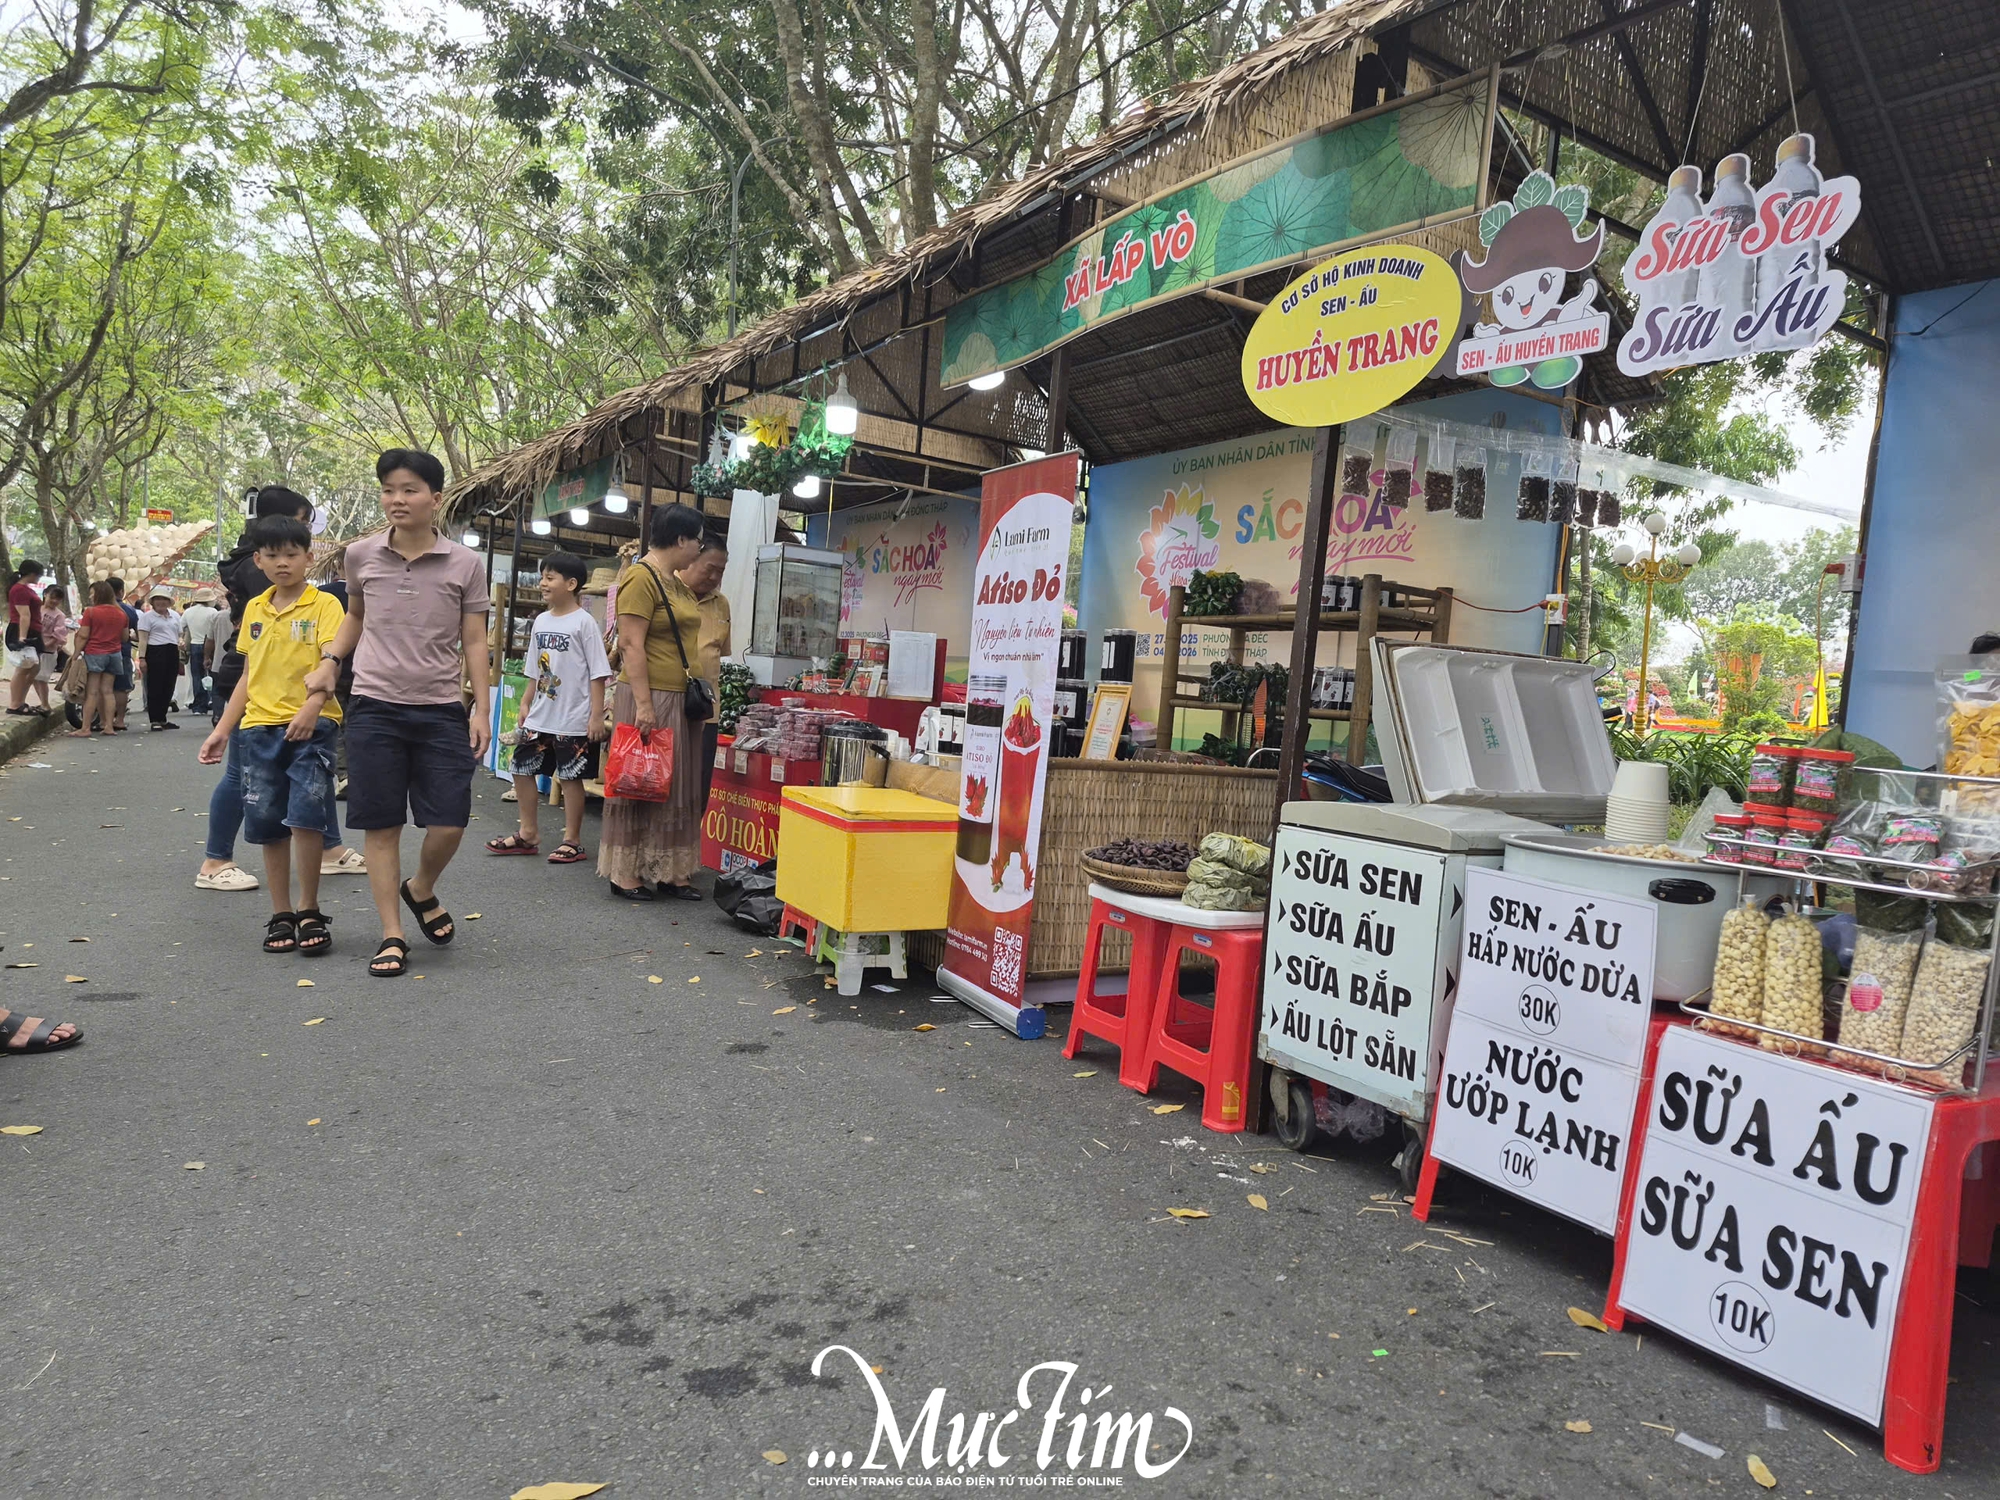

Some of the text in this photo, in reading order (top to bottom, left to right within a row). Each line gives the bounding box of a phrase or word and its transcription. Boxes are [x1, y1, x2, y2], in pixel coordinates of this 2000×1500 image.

[1062, 211, 1197, 312] XÃ LẤP VÒ
[1635, 191, 1844, 281] Sữa Sen
[1281, 257, 1425, 314] CƠ SỞ HỘ KINH DOANH
[1320, 296, 1347, 317] SEN
[1359, 284, 1377, 308] ẤU
[1628, 251, 1831, 363] Sữa Ấu
[1256, 318, 1439, 390] HUYỀN TRANG
[1461, 349, 1485, 370] SEN
[1495, 338, 1512, 365] ẤU
[1514, 331, 1555, 361] HUYỀN
[1559, 327, 1600, 352] TRANG
[1172, 459, 1188, 475] ỦY
[1190, 456, 1215, 472] BAN
[1217, 446, 1253, 467] NHÂN
[1255, 441, 1286, 463] DÂN
[1004, 527, 1050, 547] Lami Farm
[1235, 487, 1393, 544] SẮC OA
[1357, 521, 1416, 556] mới
[872, 531, 936, 573] SẮC HOA
[1160, 540, 1219, 576] Festival
[977, 564, 1061, 605] Atiso Đỏ
[1203, 632, 1231, 644] PHƯỜN
[1252, 632, 1268, 644] ĐÉC
[1203, 644, 1219, 657] TỈNH
[1246, 646, 1267, 657] THÁP
[706, 805, 728, 842] CÔ
[710, 787, 718, 798] CƠ
[719, 787, 726, 800] SỞ
[727, 791, 738, 805] CHẾ
[738, 793, 750, 808] BIẾN
[751, 798, 768, 814] THỰC
[1294, 848, 1422, 906] SỮA SEN
[1289, 901, 1395, 956] SỮA ẤU
[1489, 895, 1542, 933] SEN
[1564, 903, 1622, 950] ẤU
[1285, 954, 1412, 1018] SỮA BẮP
[1467, 925, 1642, 1005] HẤP NƯỚC DỪA
[1520, 993, 1557, 1027] 30K
[1282, 1000, 1417, 1082] ẤU LỘT SẴN
[1485, 1039, 1583, 1103] NƯỚC
[1446, 1071, 1621, 1172] ƯỚP LẠNH
[1659, 1064, 1909, 1206] SỮA ẤU
[1503, 1148, 1535, 1181] 10K
[1640, 1169, 1890, 1329] SỮA SEN
[1715, 1292, 1772, 1345] 10K
